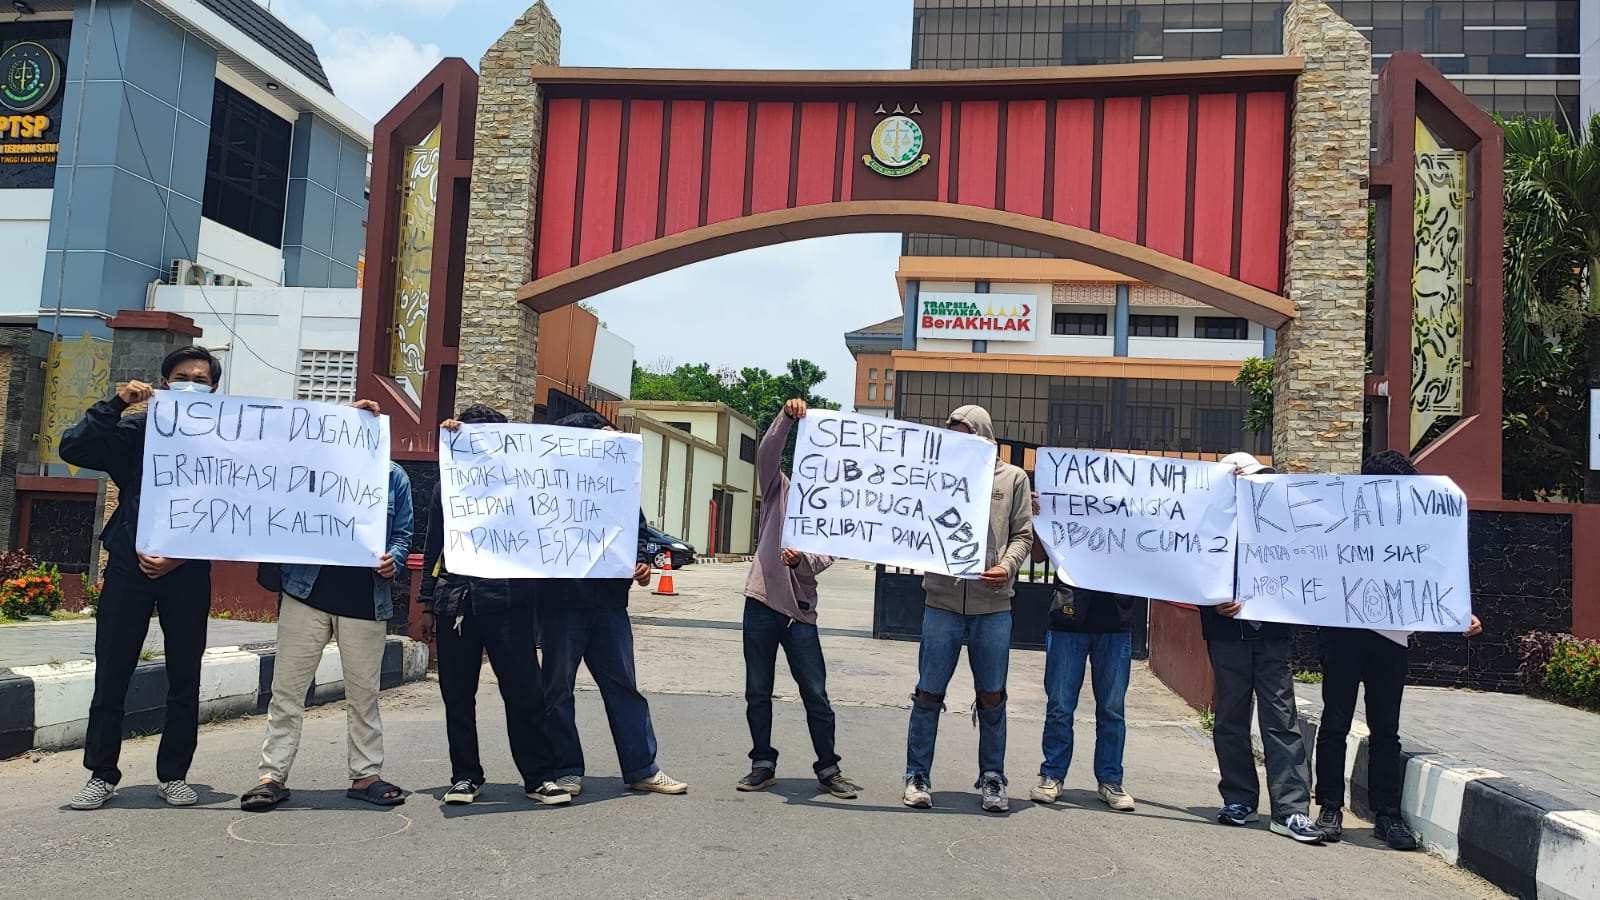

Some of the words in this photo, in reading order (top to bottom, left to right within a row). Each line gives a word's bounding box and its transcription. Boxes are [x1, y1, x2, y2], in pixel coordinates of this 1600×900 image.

[922, 308, 981, 317] ADHYAKSA
[923, 301, 977, 310] TRAPSILA
[922, 316, 1031, 331] BerAKHLAK
[154, 400, 283, 441] USUT
[289, 407, 380, 450] DUGAAN
[450, 431, 532, 460] KEJATI
[539, 434, 627, 464] SEGERA
[153, 453, 276, 491] GRATIFIKASI
[576, 473, 625, 494] HASIL
[799, 453, 863, 483] GUB
[891, 465, 971, 503] SEKDA
[1048, 452, 1135, 487] YAKIN
[1150, 463, 1186, 494] NIH
[562, 498, 601, 523] JUTA
[797, 482, 830, 514] YG
[1041, 492, 1185, 520] TERSANGKA
[1250, 477, 1402, 533] KEJATI
[169, 498, 251, 537] ESDM
[268, 506, 355, 541] KALTIM
[789, 516, 883, 542] TERLIBAT
[891, 526, 934, 555] DANA
[537, 526, 607, 567] ESDM
[1050, 521, 1126, 553] DBON
[1136, 529, 1200, 554] CUMA
[1208, 536, 1229, 553] 2
[1336, 544, 1374, 564] KAMI
[1383, 543, 1427, 564] SIAP
[1301, 578, 1328, 605] KE
